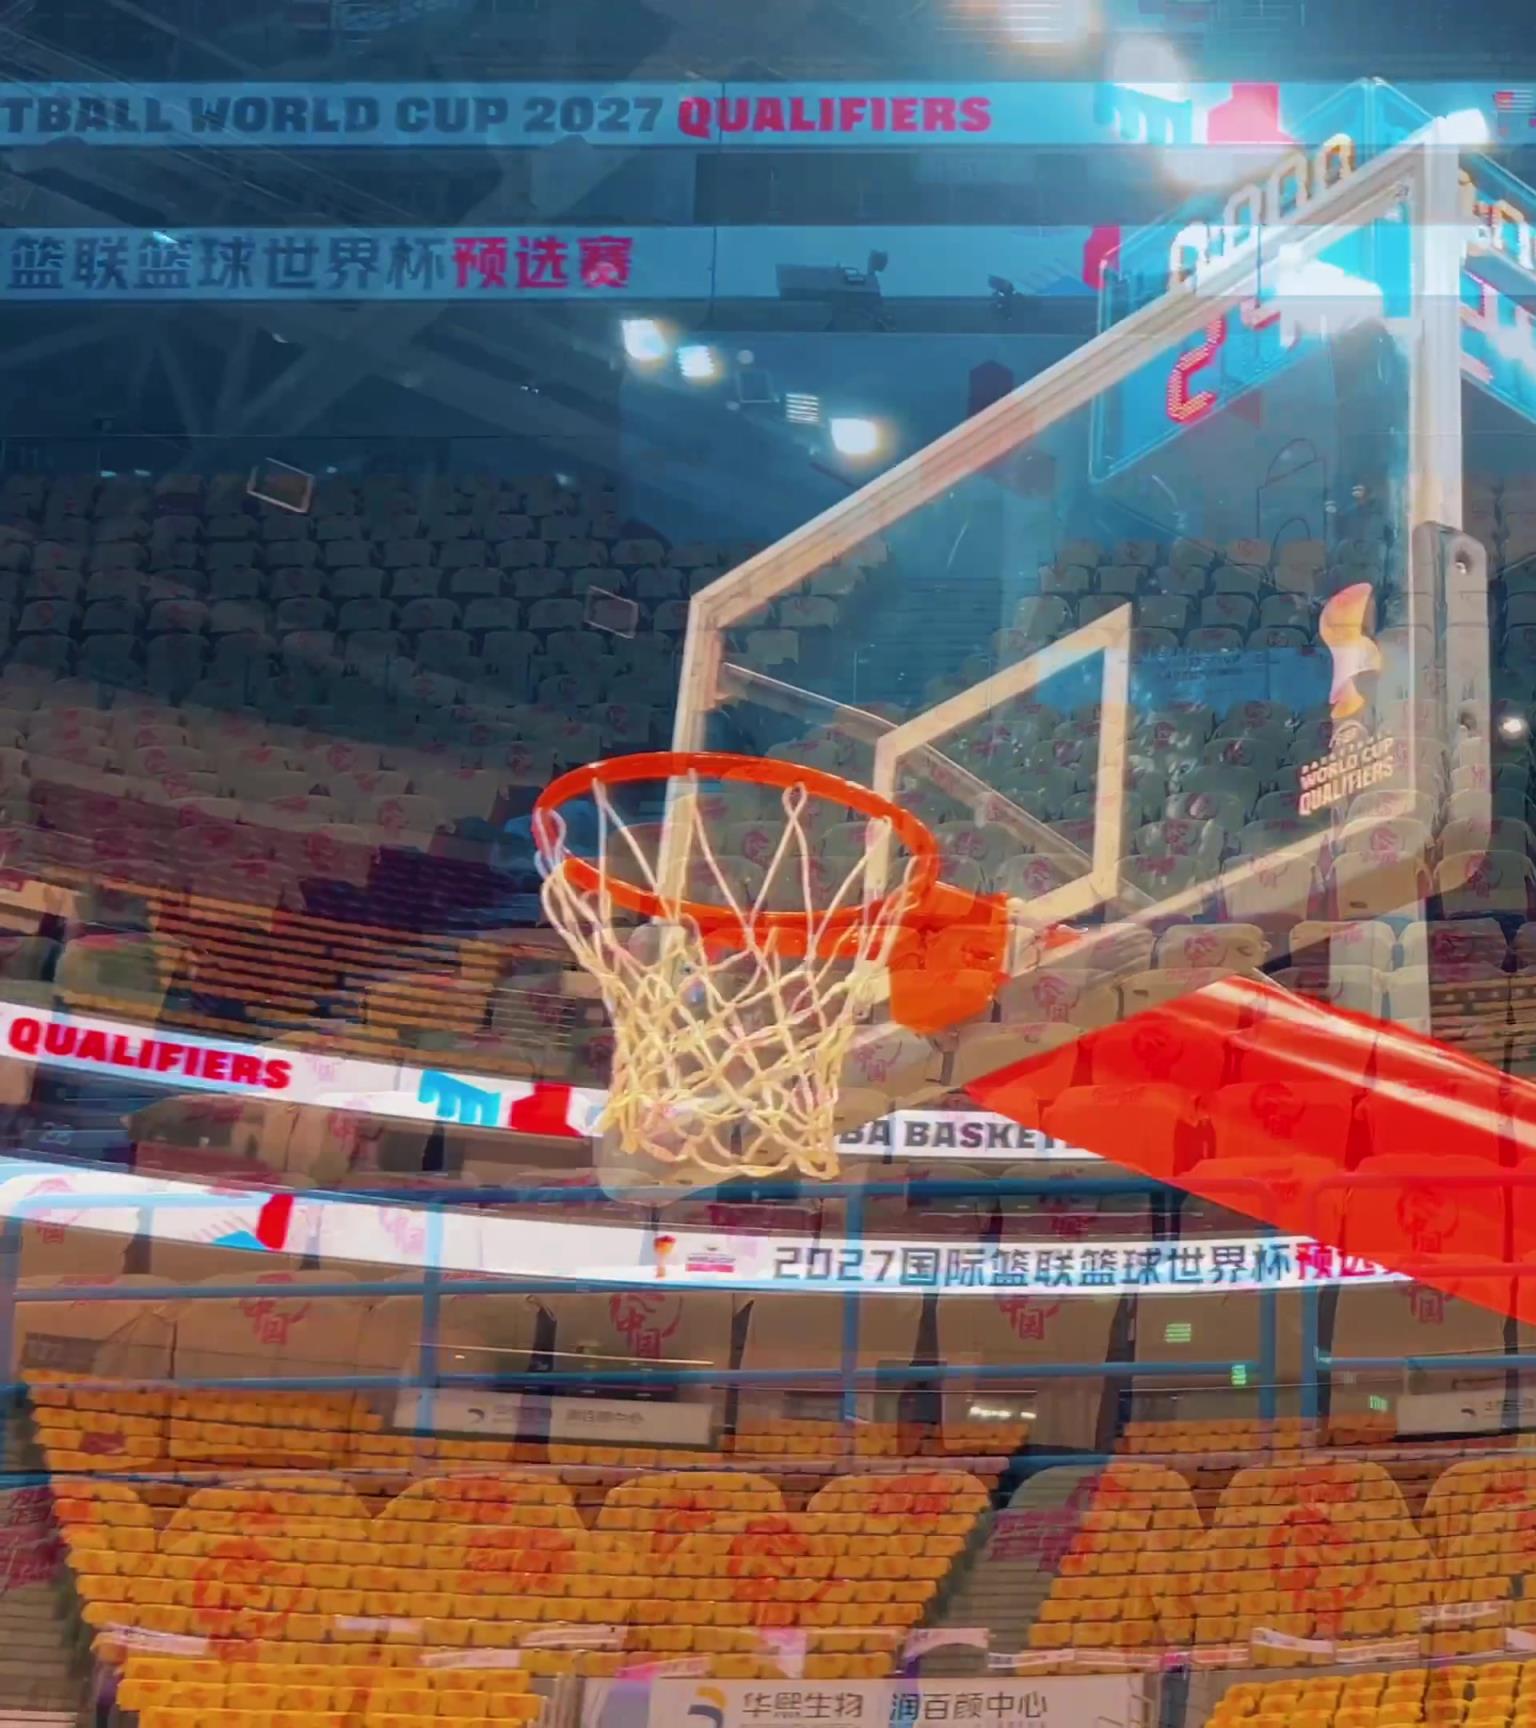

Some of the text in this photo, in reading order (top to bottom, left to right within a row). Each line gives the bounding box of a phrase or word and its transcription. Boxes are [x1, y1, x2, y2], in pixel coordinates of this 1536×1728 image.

[191, 96, 380, 134] WORLD
[394, 96, 509, 133] CUP
[523, 96, 663, 133] 2027
[677, 95, 992, 139] QUALIFIERS
[6, 235, 634, 290] 篮联篮球世界杯预选赛
[1299, 756, 1394, 816] QUALIFIERS
[1301, 754, 1358, 789] WORLD
[1362, 738, 1394, 763] CUP
[8, 1017, 294, 1090] QUALIFIERS
[890, 1691, 1049, 1721] 润百颜中心
